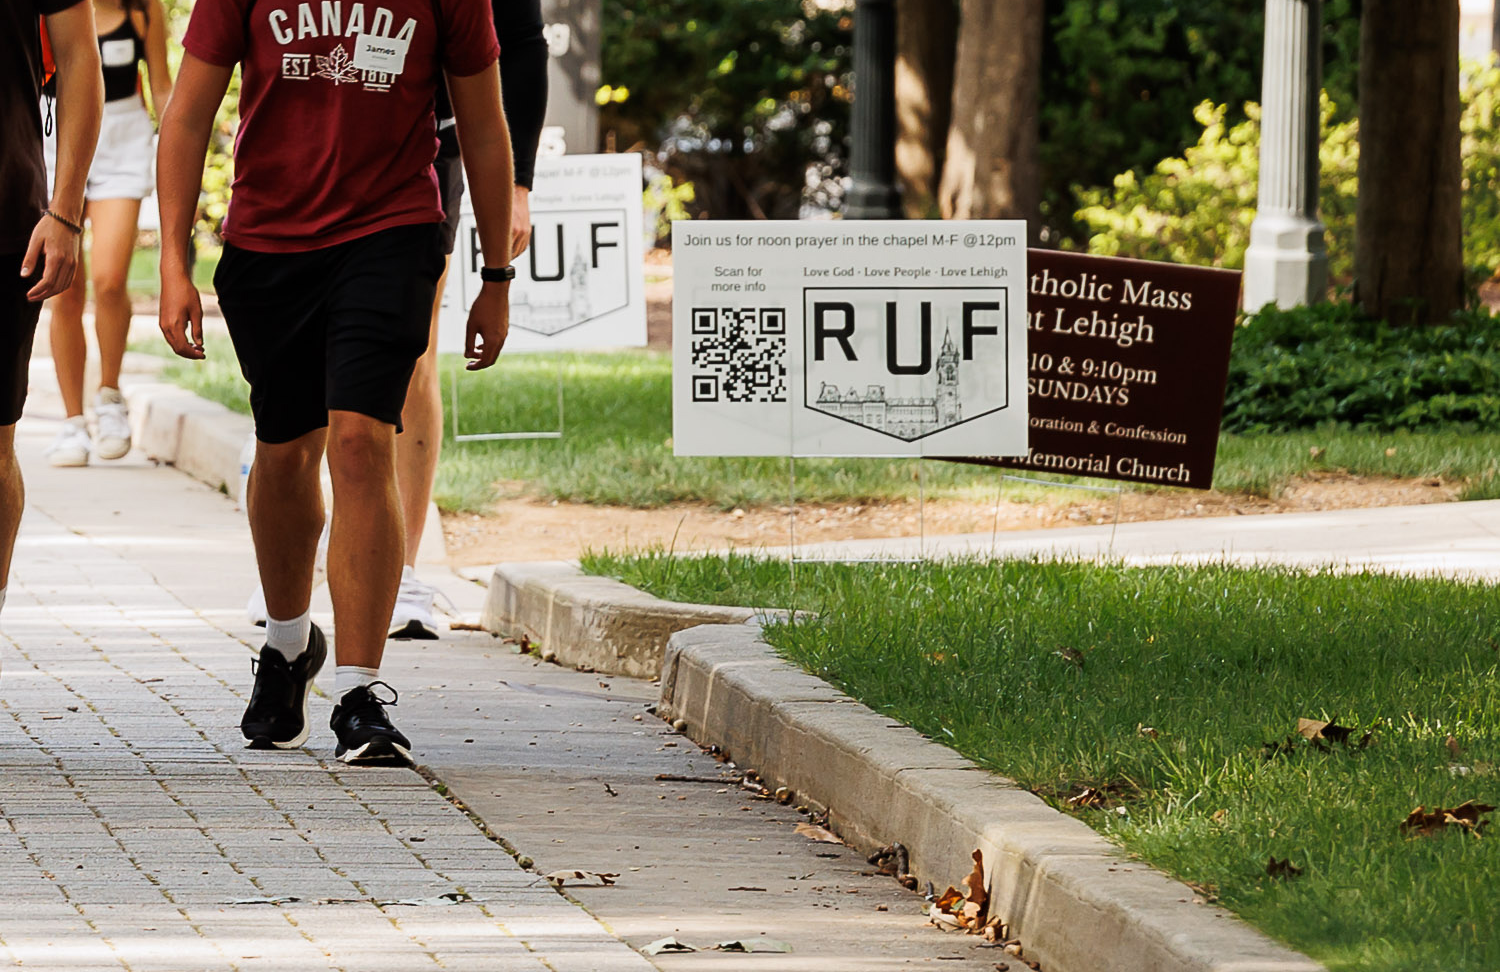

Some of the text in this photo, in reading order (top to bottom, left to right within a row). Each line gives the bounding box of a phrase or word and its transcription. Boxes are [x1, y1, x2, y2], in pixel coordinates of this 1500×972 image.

[366, 44, 396, 56] James
[684, 234, 1016, 249] Join us for noon prayer in the chapel M-F @12pm
[714, 266, 763, 277] Scan for
[803, 267, 1008, 279] Love God Love People Love Lehigh
[711, 281, 766, 292] more info
[1031, 269, 1192, 311] tholic Mass
[1052, 307, 1154, 347] Lehigh
[1030, 352, 1157, 386] 10 & 9:10pm
[1028, 377, 1130, 406] SUNDAYS
[1030, 416, 1187, 445] oration & Confession
[1012, 447, 1190, 483] Memorial Church
